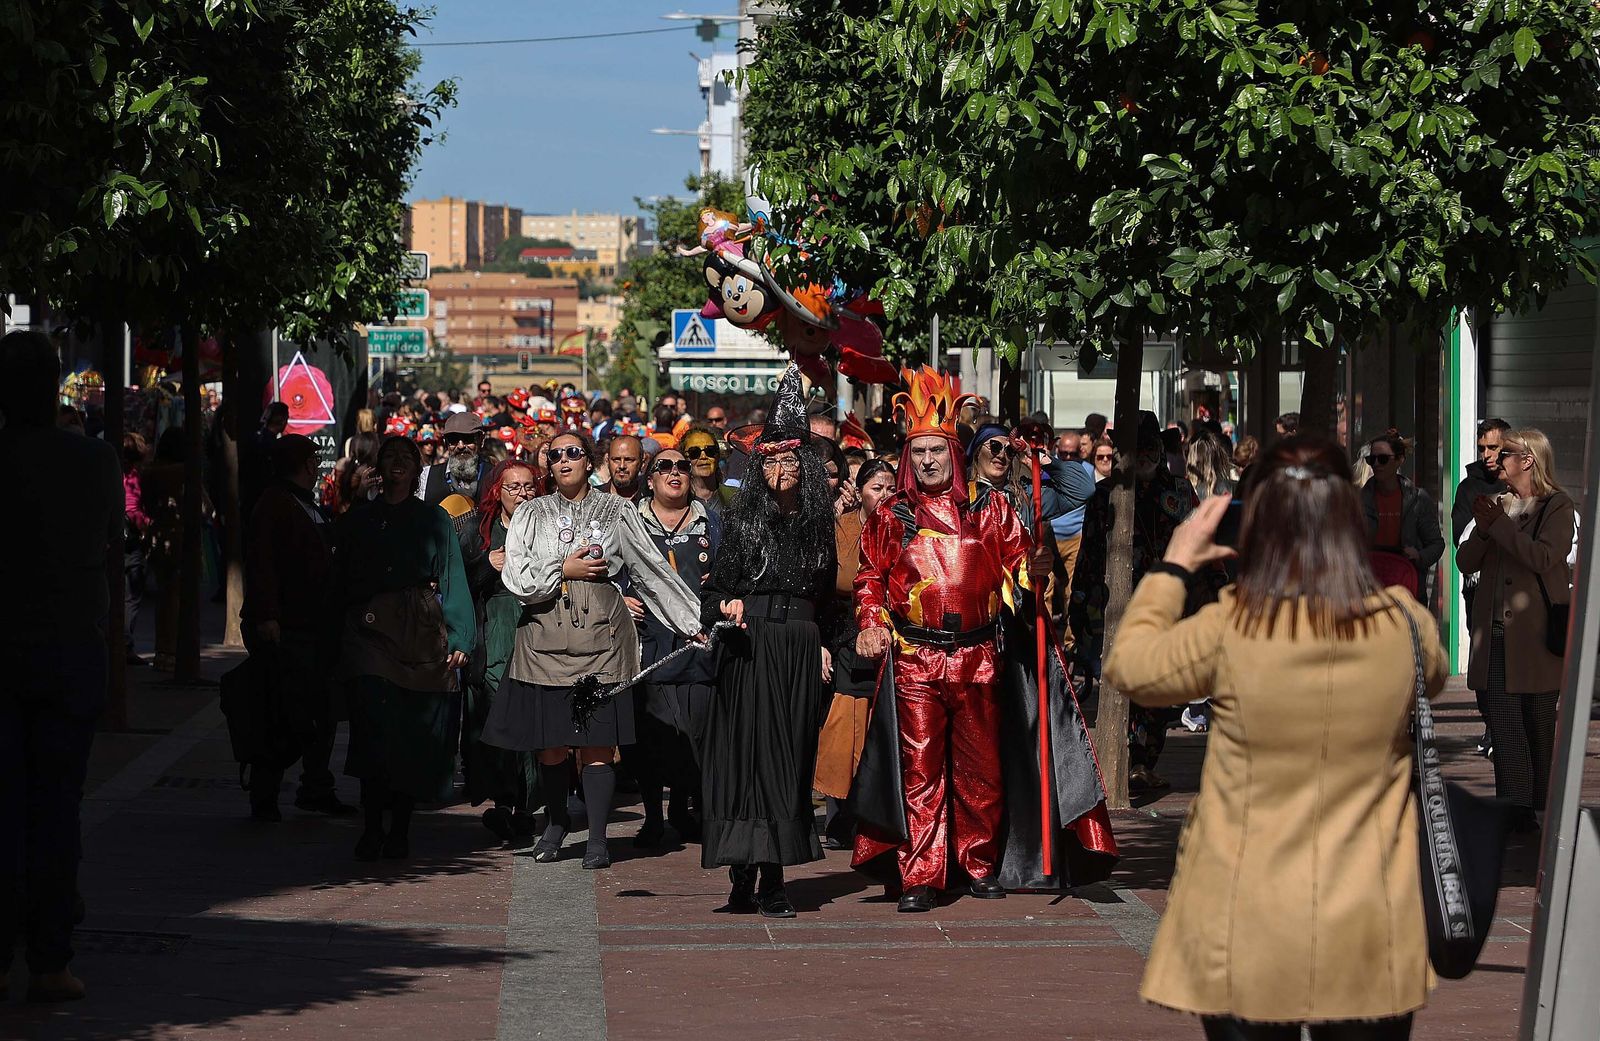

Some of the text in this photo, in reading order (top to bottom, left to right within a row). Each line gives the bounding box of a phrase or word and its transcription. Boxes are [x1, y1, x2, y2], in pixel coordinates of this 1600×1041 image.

[373, 332, 420, 341] barrio de
[368, 342, 420, 352] an Isidro
[744, 377, 766, 392] LA
[1424, 766, 1444, 794] ME
[1441, 873, 1466, 916] IRSE
